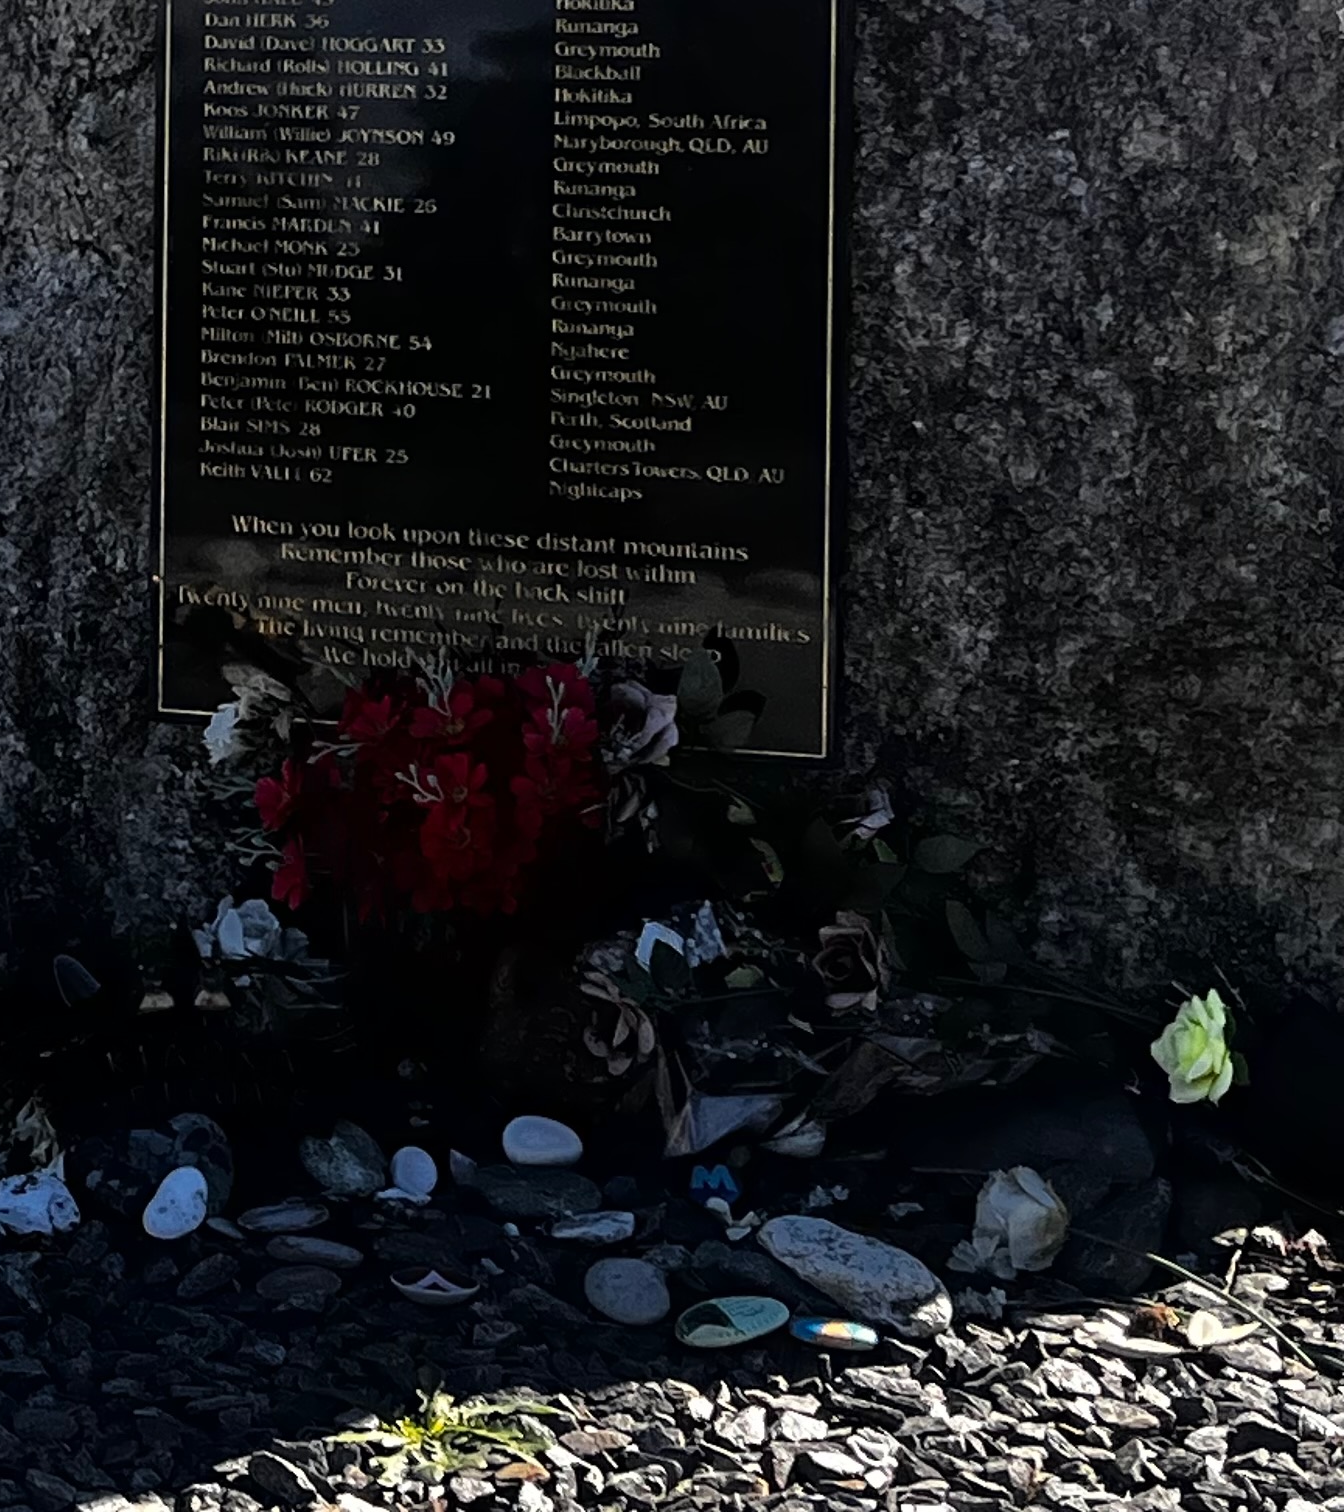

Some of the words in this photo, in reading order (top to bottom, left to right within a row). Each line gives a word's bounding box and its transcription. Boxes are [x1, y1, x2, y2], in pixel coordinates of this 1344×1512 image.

[556, 19, 638, 37] Runanga
[555, 42, 660, 60] Greymouth
[556, 66, 641, 80] Blackball
[555, 89, 632, 103] Hokitika
[649, 113, 704, 129] South
[712, 115, 766, 130] Africa
[743, 139, 768, 154] AU
[553, 158, 659, 176] Greymouth
